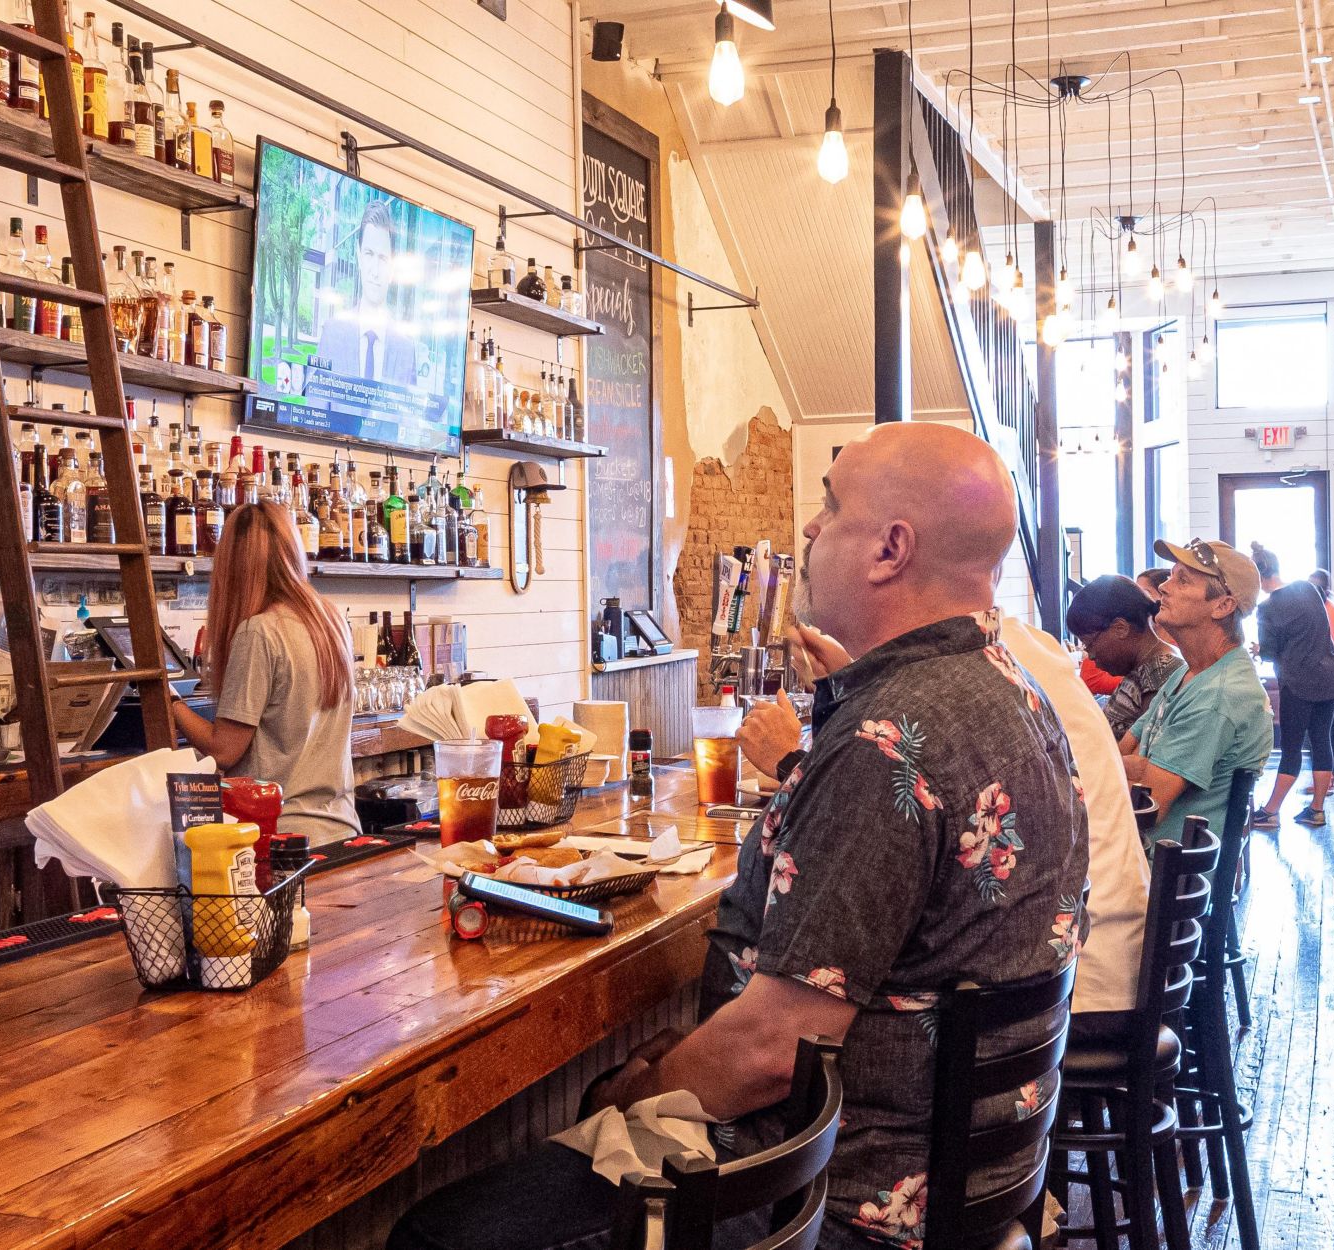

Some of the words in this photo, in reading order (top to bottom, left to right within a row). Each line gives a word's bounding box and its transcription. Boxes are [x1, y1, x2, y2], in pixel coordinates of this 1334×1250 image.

[608, 167, 647, 224] SQUARE
[256, 400, 275, 412] ESPN
[1263, 426, 1290, 446] EXIT
[456, 781, 498, 802] Coca-Cola
